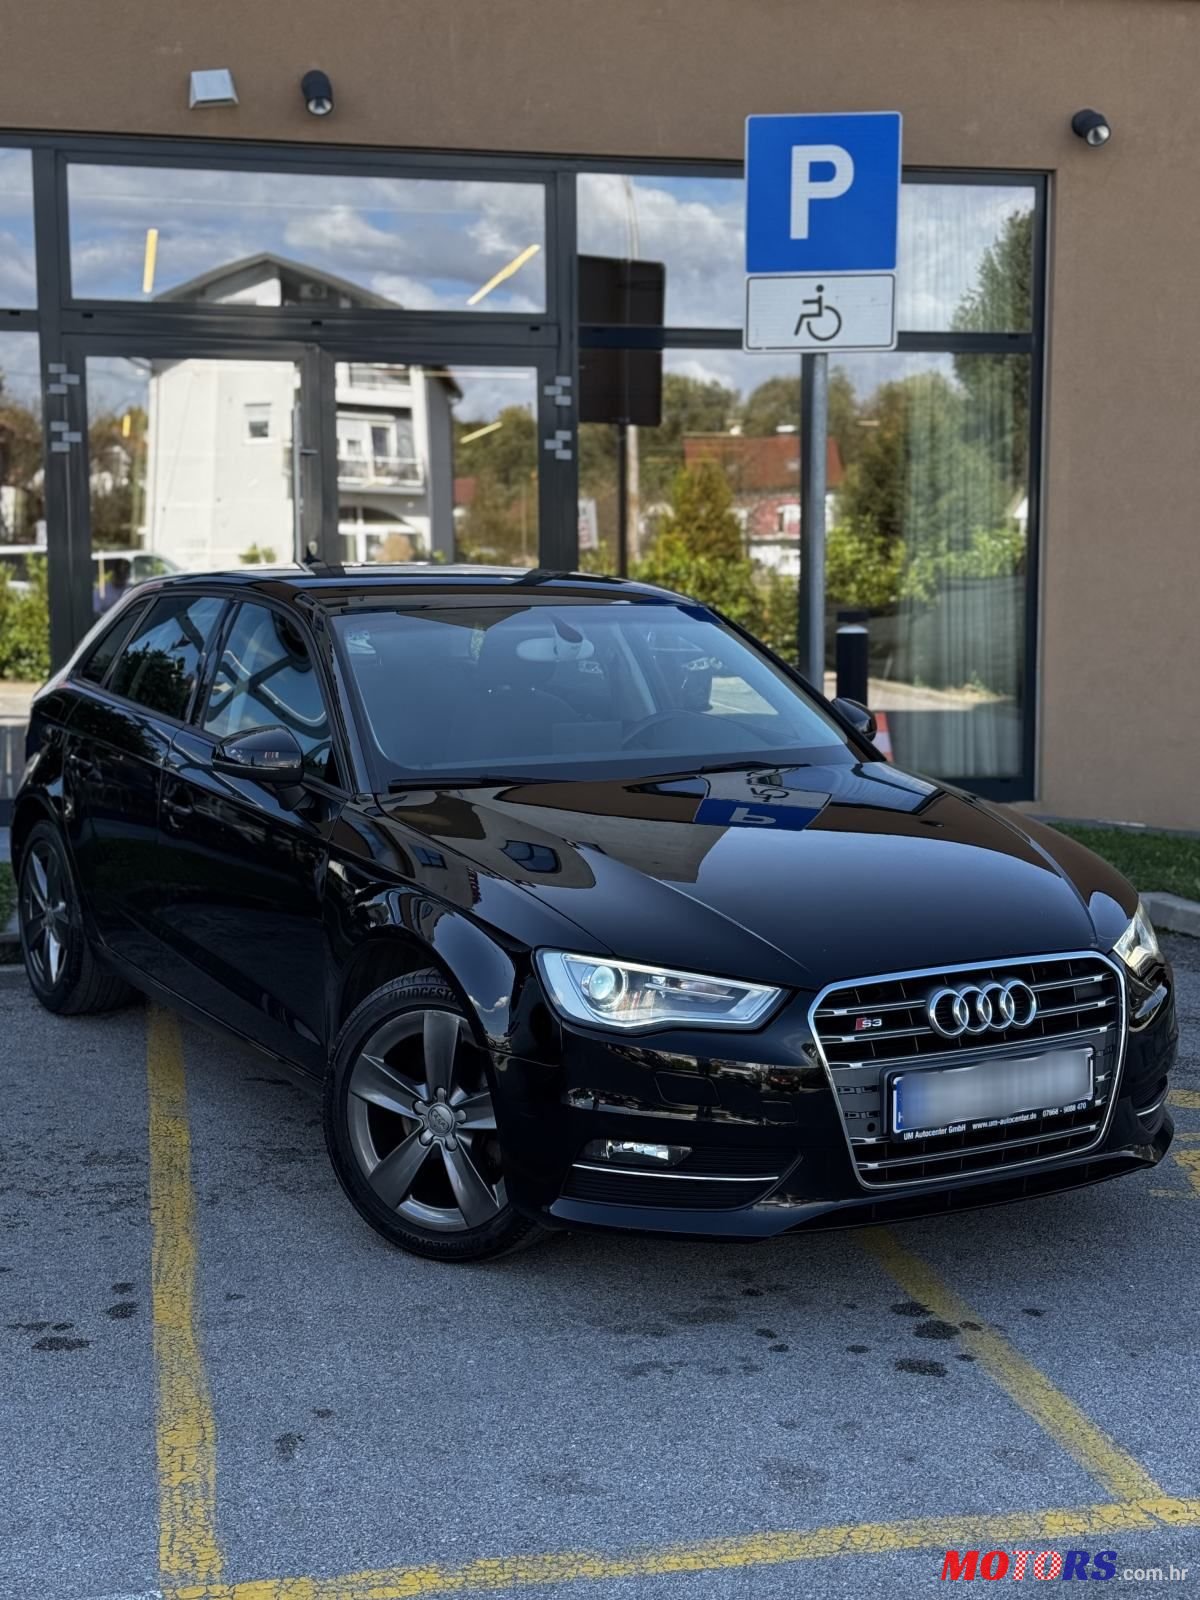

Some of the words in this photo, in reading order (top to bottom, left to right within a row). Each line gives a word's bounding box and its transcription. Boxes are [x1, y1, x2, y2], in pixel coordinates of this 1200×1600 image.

[790, 144, 854, 240] P
[862, 1018, 882, 1028] S3
[903, 1131, 914, 1140] UM
[915, 1127, 947, 1139] Autocenter
[948, 1124, 966, 1134] GmbH
[972, 1112, 1037, 1130] www.um-autocenter.de
[1076, 1101, 1087, 1110] 470
